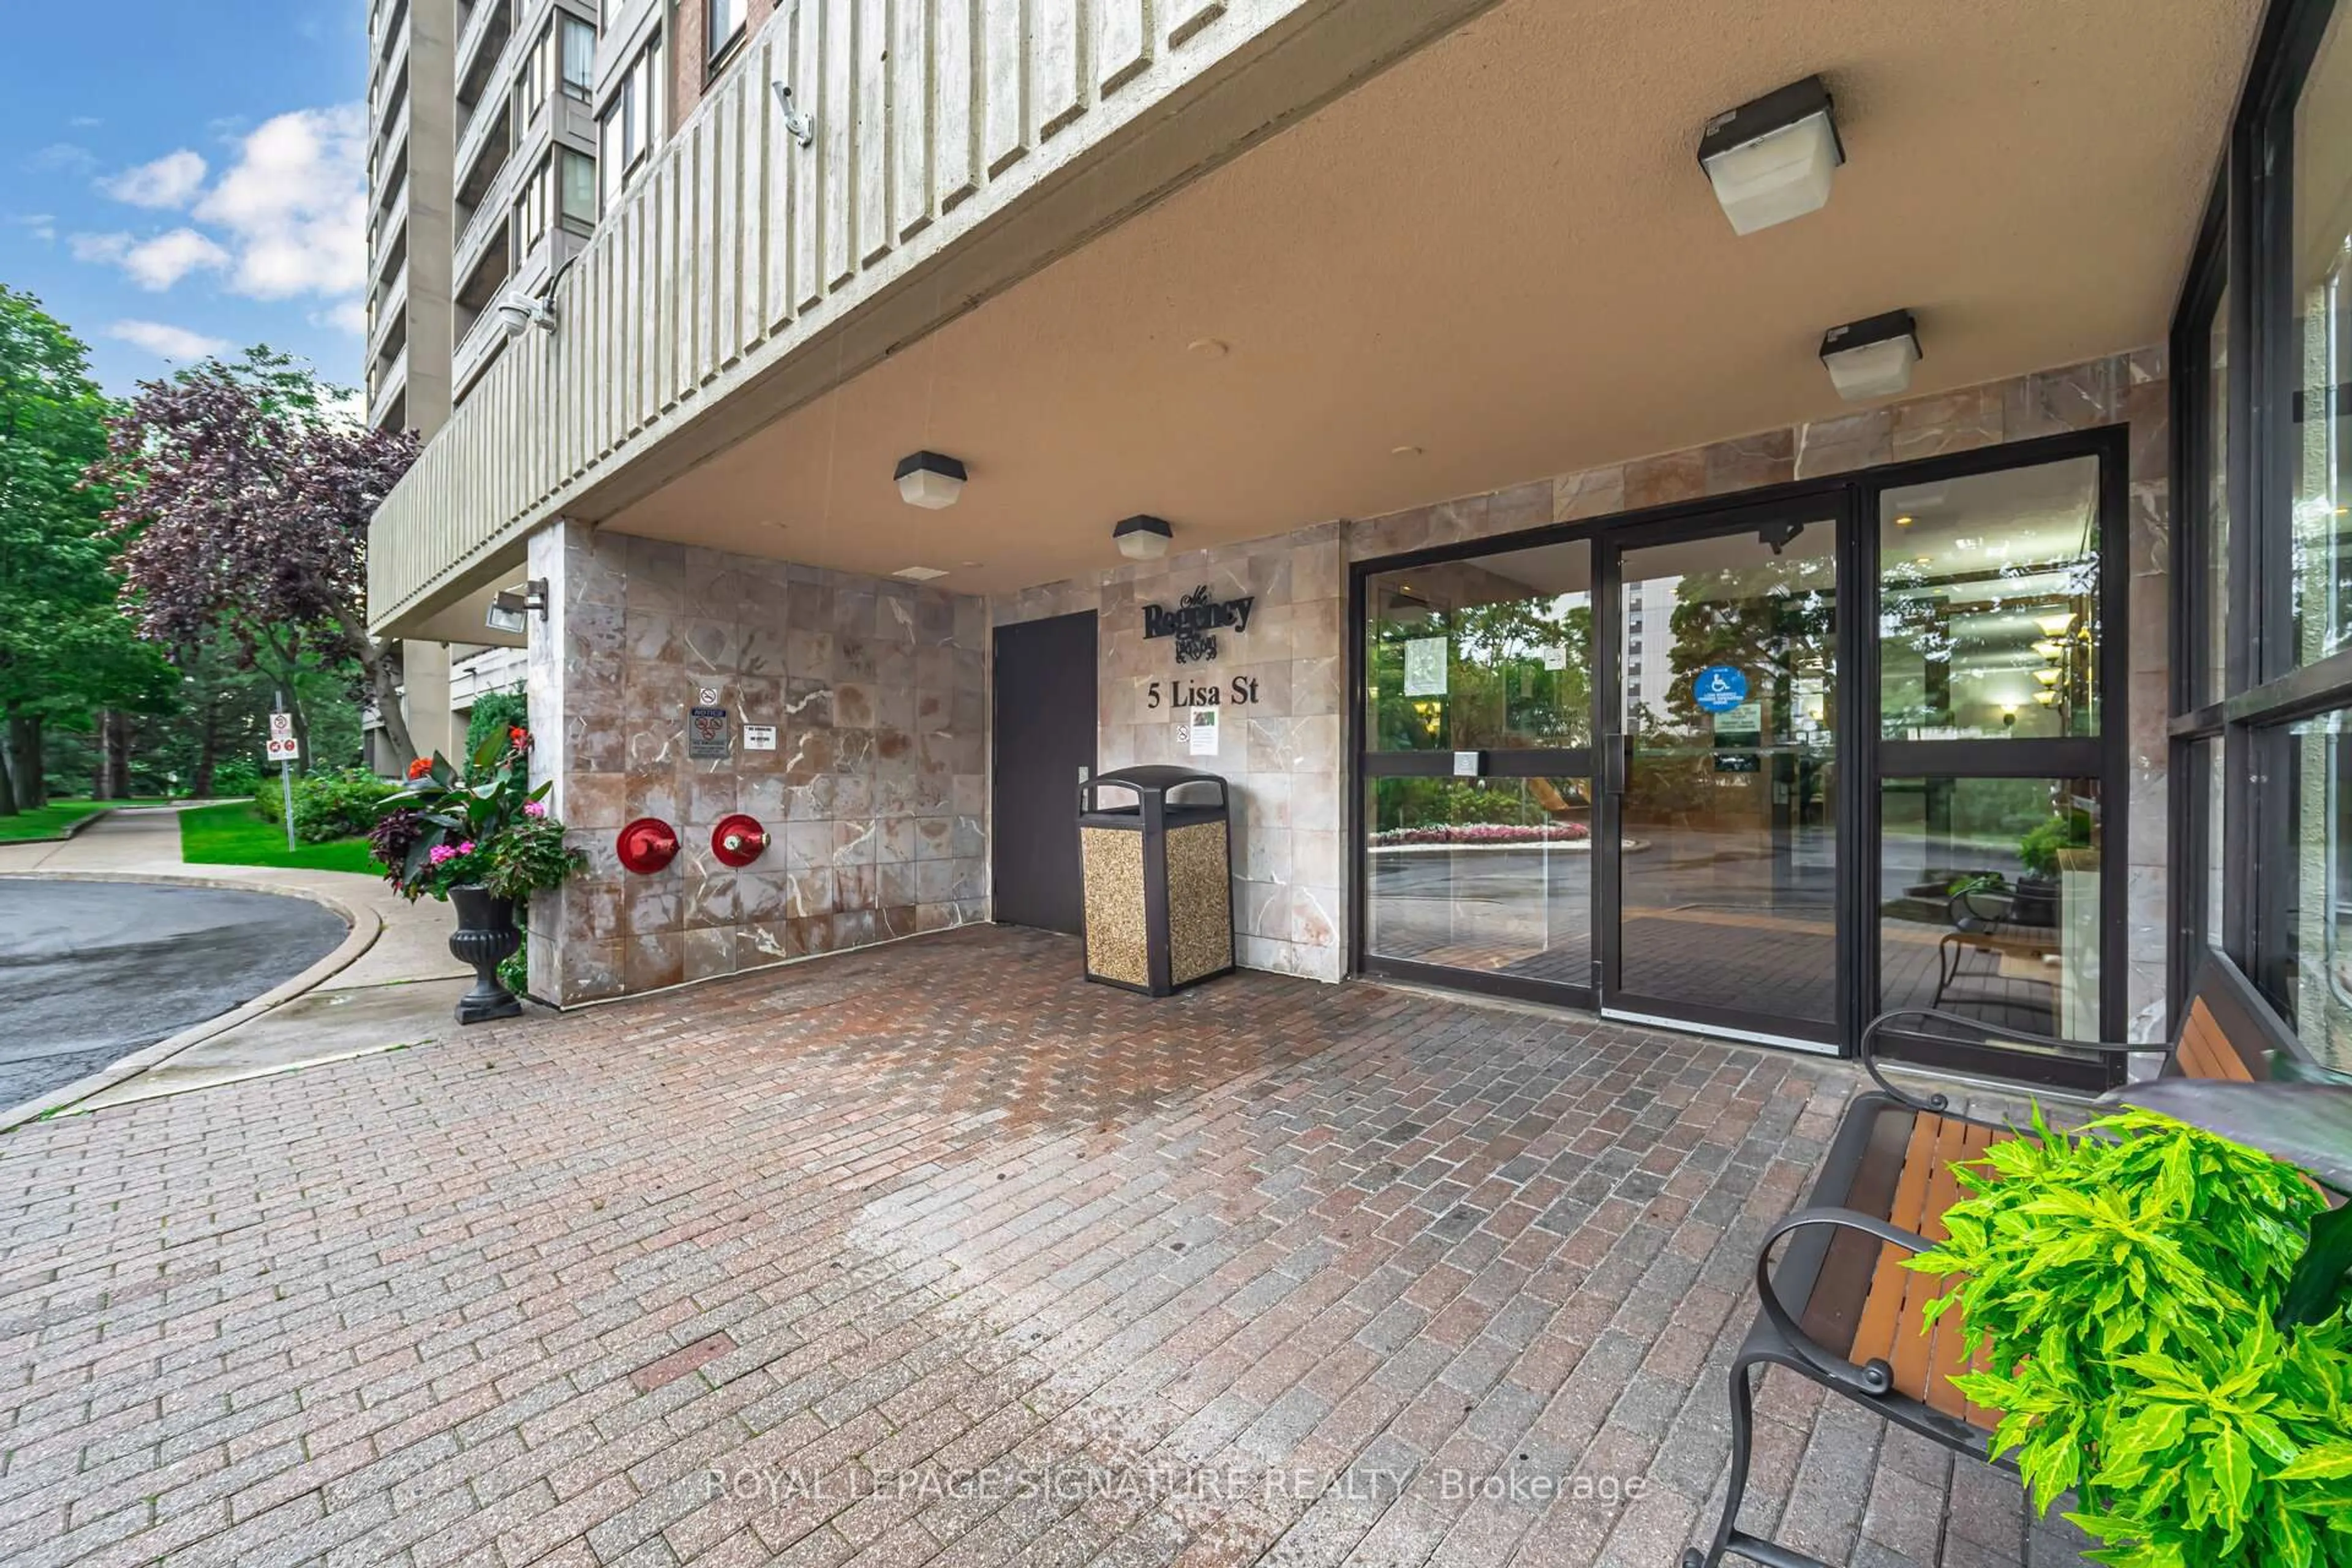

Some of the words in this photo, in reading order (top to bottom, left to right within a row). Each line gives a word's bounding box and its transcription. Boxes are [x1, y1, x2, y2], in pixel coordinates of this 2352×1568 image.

[1148, 682, 1161, 709] 5
[1170, 679, 1221, 708] Lisa
[1231, 676, 1259, 705] St
